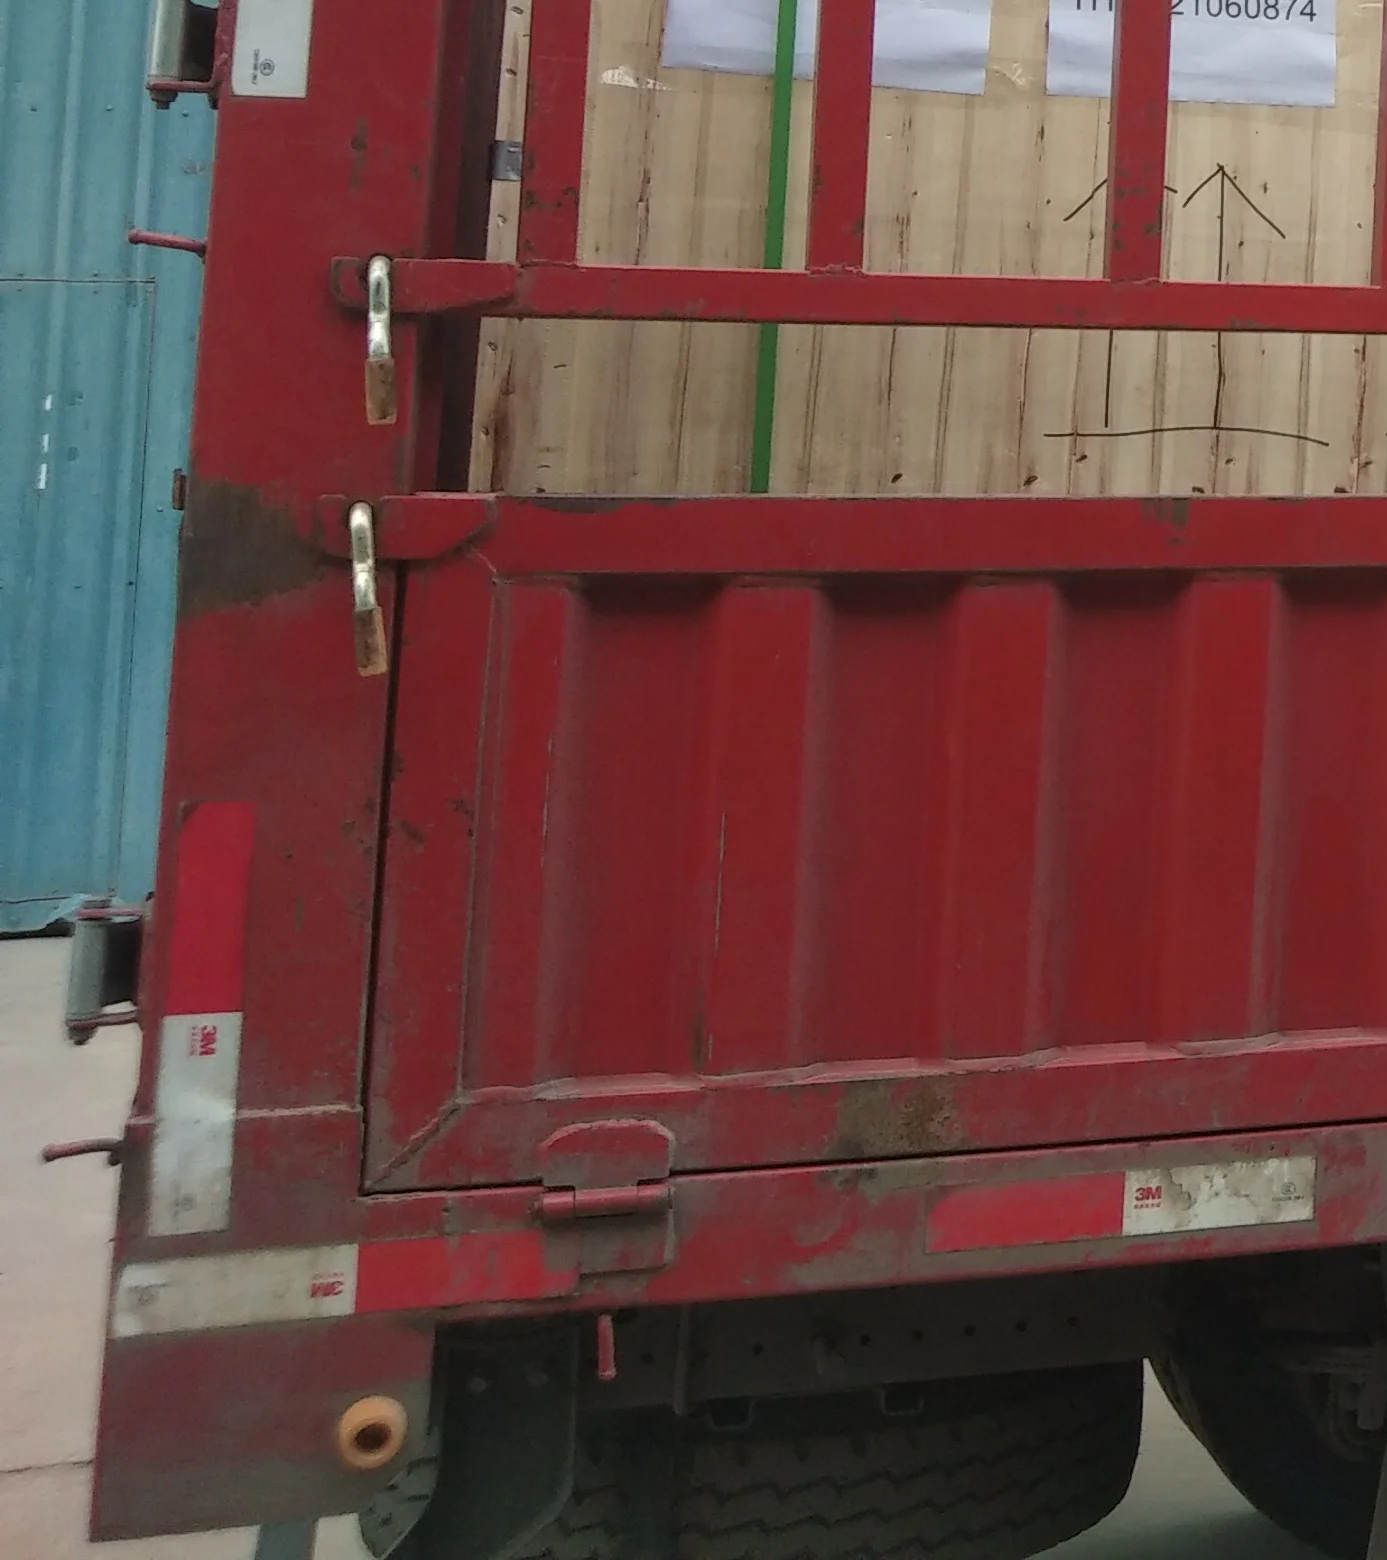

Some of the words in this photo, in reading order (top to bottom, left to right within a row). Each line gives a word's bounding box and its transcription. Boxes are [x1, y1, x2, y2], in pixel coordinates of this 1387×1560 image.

[198, 1025, 217, 1056] 3M
[1134, 1185, 1162, 1202] 3M
[309, 1280, 344, 1299] 3M
